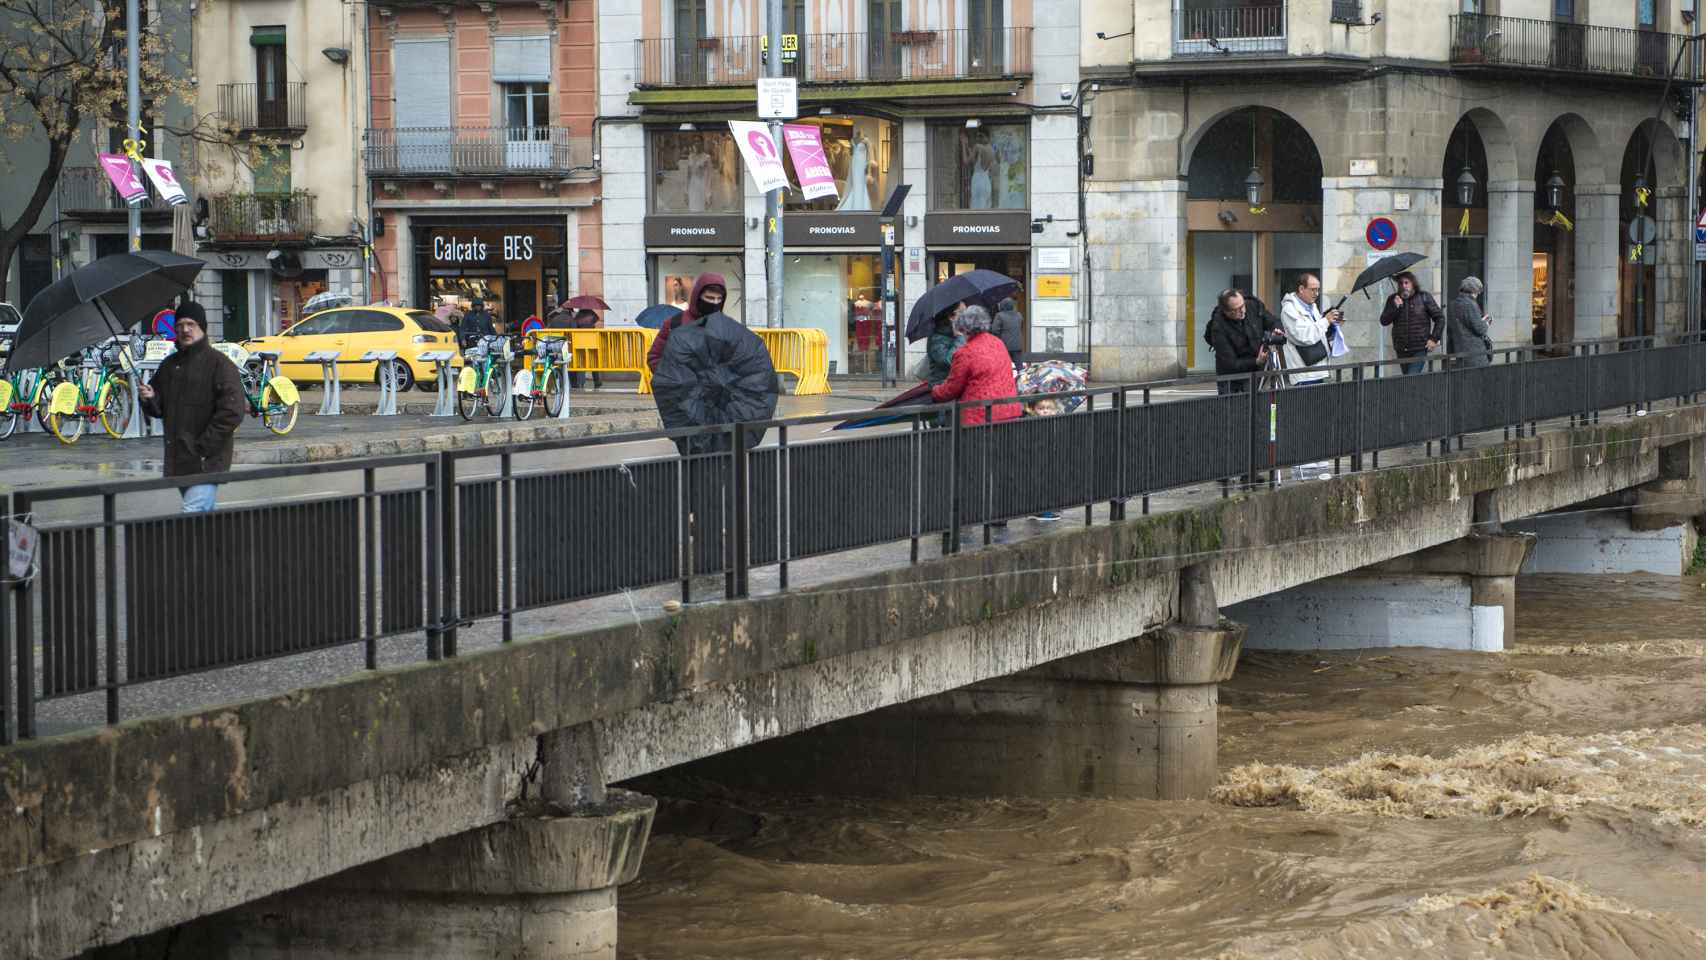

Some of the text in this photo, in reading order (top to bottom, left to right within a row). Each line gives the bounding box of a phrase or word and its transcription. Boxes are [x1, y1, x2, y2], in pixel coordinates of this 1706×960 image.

[671, 227, 716, 235] PRONOVIAS
[809, 226, 856, 234] PRONOVIAS
[952, 225, 1000, 233] PRONOVIAS
[434, 235, 533, 263] Calçats BES
